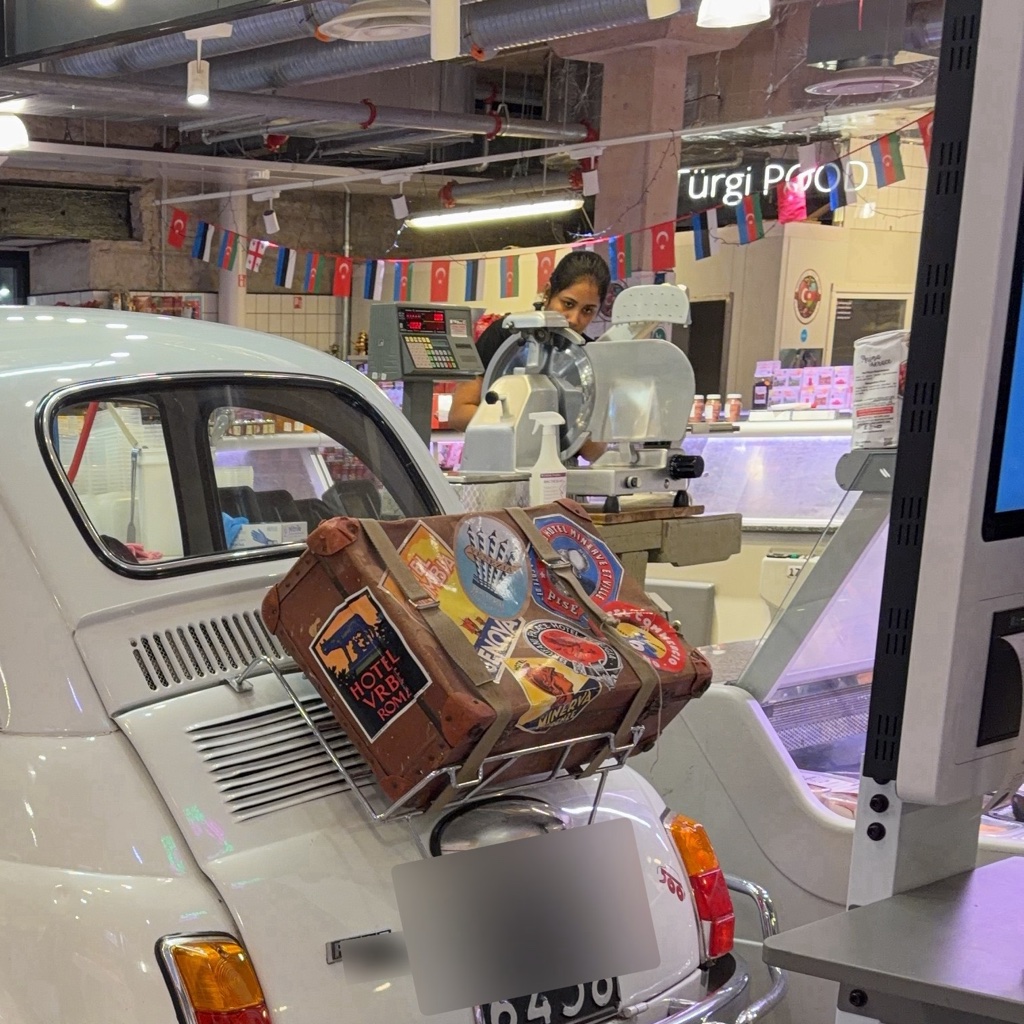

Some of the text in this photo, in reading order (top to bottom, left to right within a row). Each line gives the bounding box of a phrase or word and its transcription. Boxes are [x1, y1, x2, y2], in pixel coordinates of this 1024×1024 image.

[547, 590, 580, 615] PISE
[349, 649, 401, 701] HOTEL
[538, 690, 593, 727] MINERVA
[659, 867, 684, 902] 500
